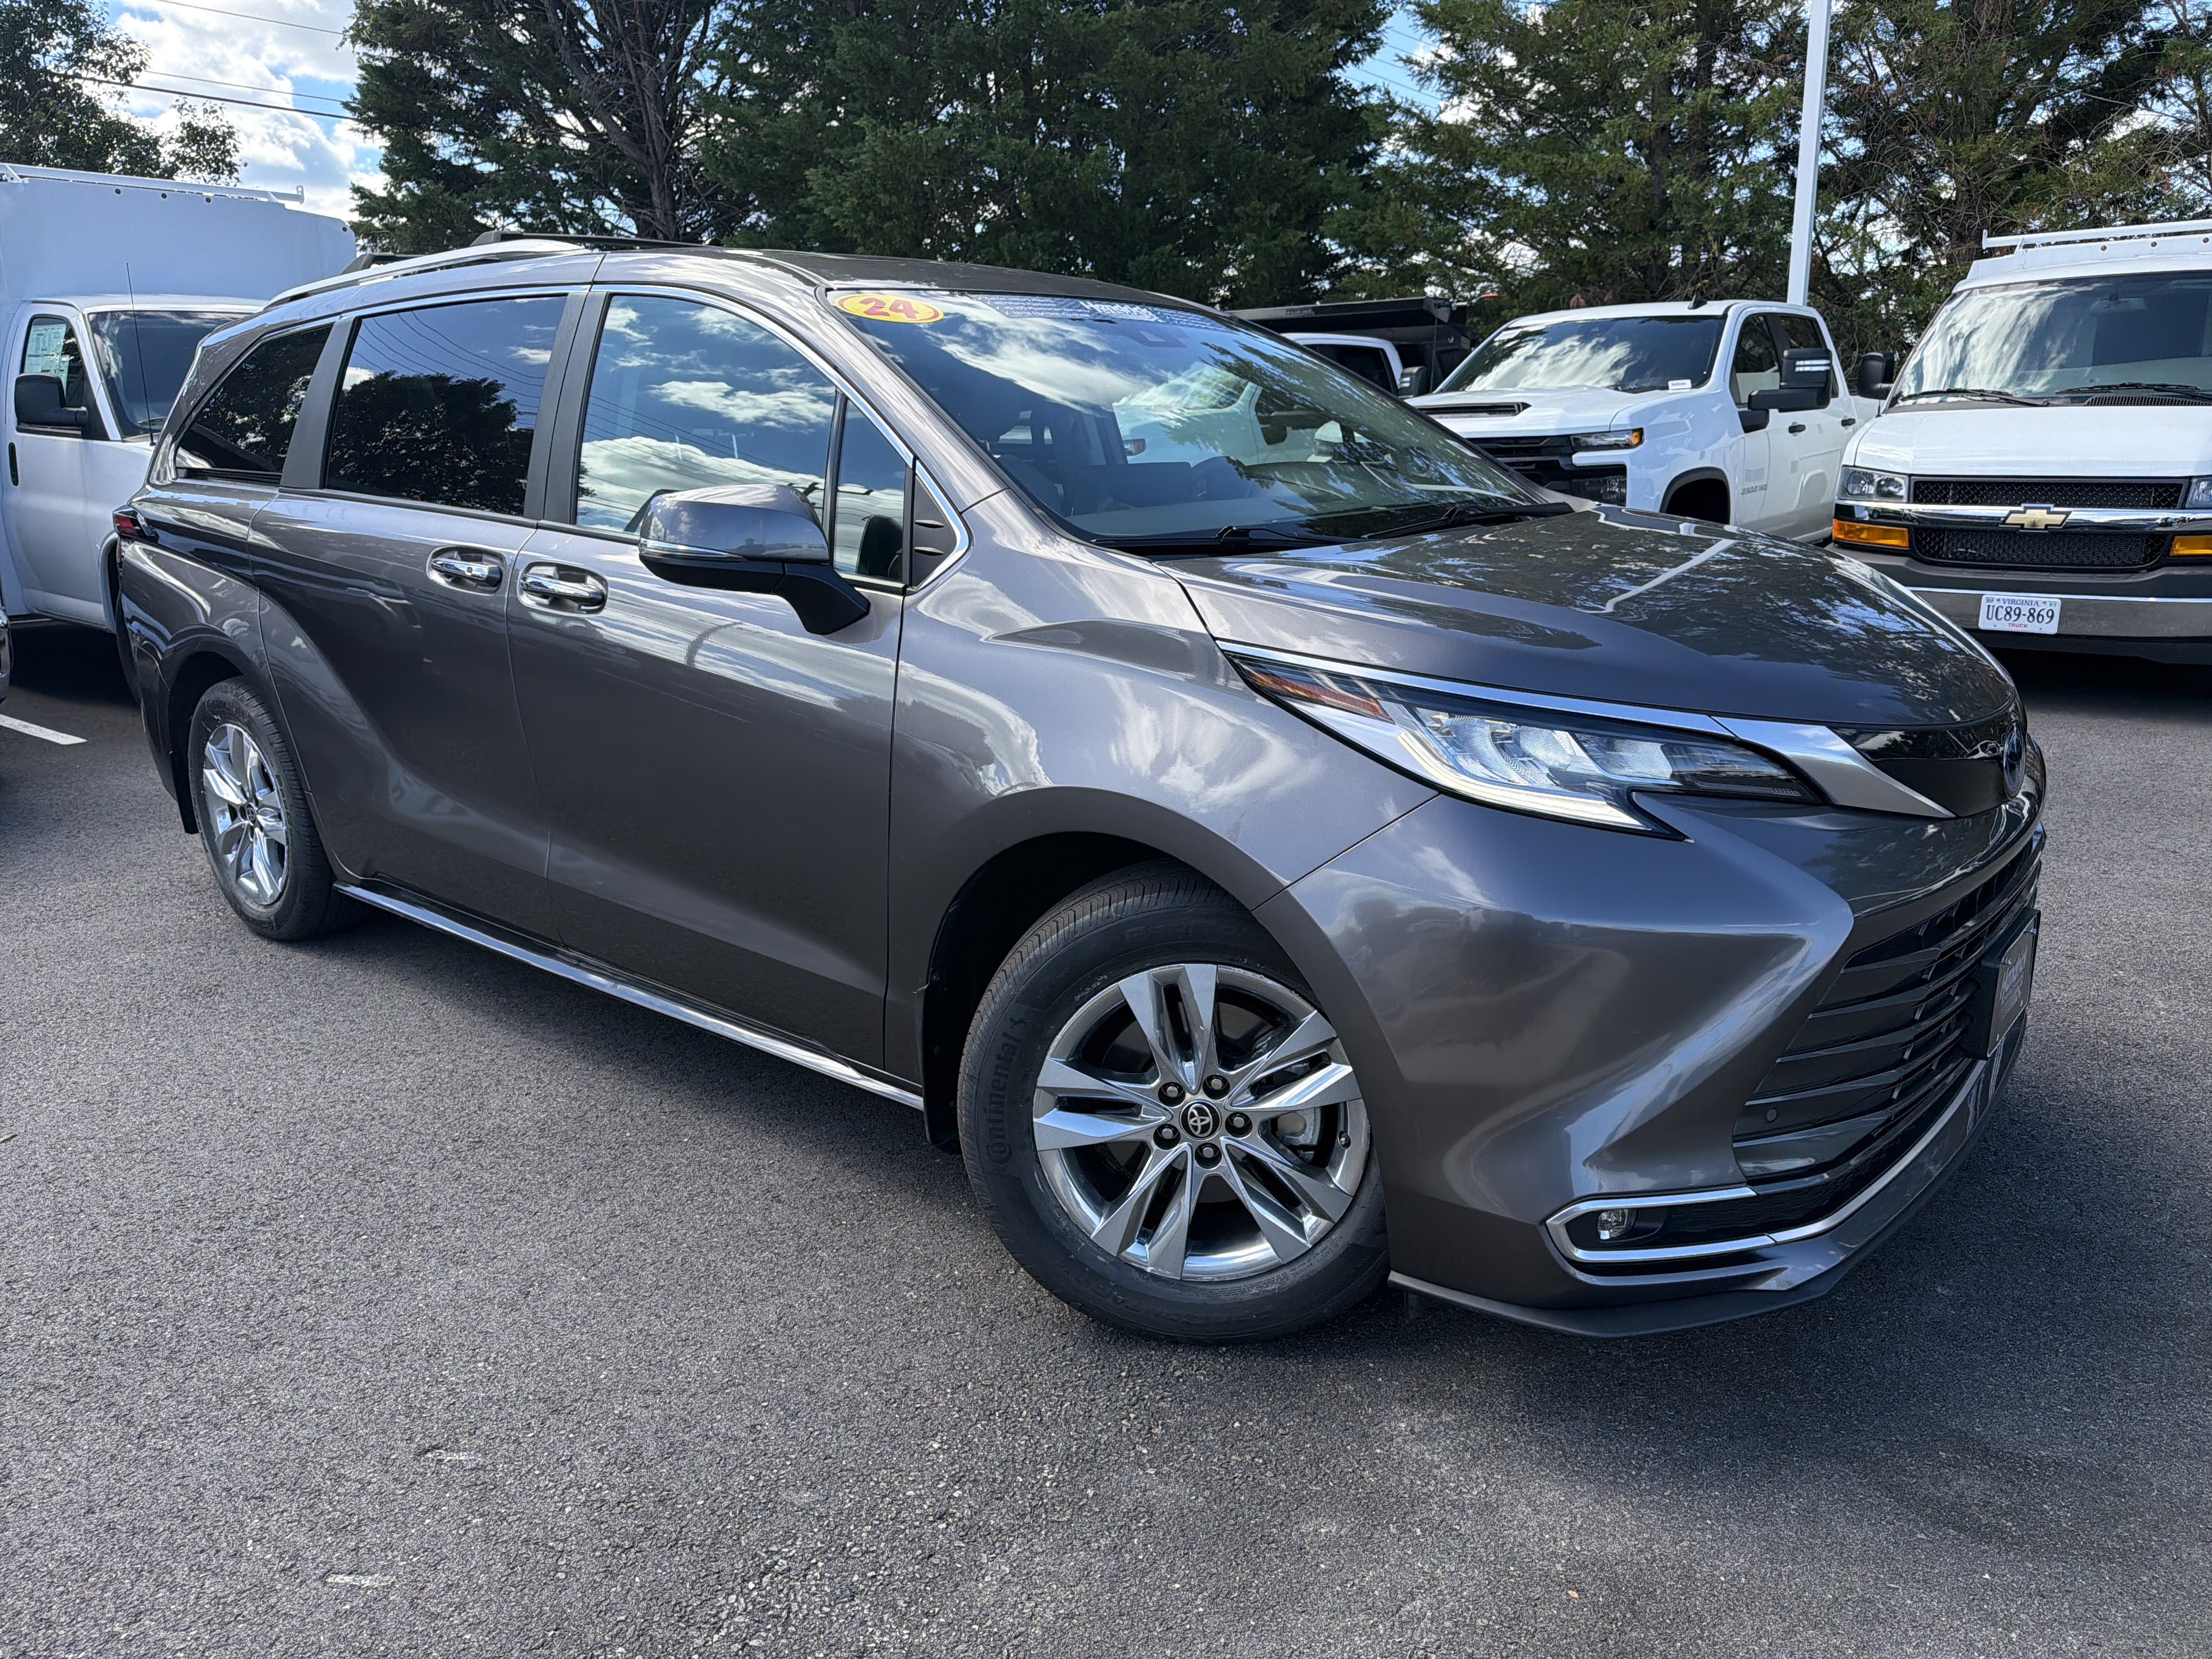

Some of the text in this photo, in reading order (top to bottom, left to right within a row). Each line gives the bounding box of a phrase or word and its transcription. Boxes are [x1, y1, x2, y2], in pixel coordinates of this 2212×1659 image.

[859, 298, 919, 319] 24
[2002, 598, 2039, 607] VIRGINIA
[1986, 605, 2055, 624] UC89-869
[984, 1031, 1022, 1165] Continental
